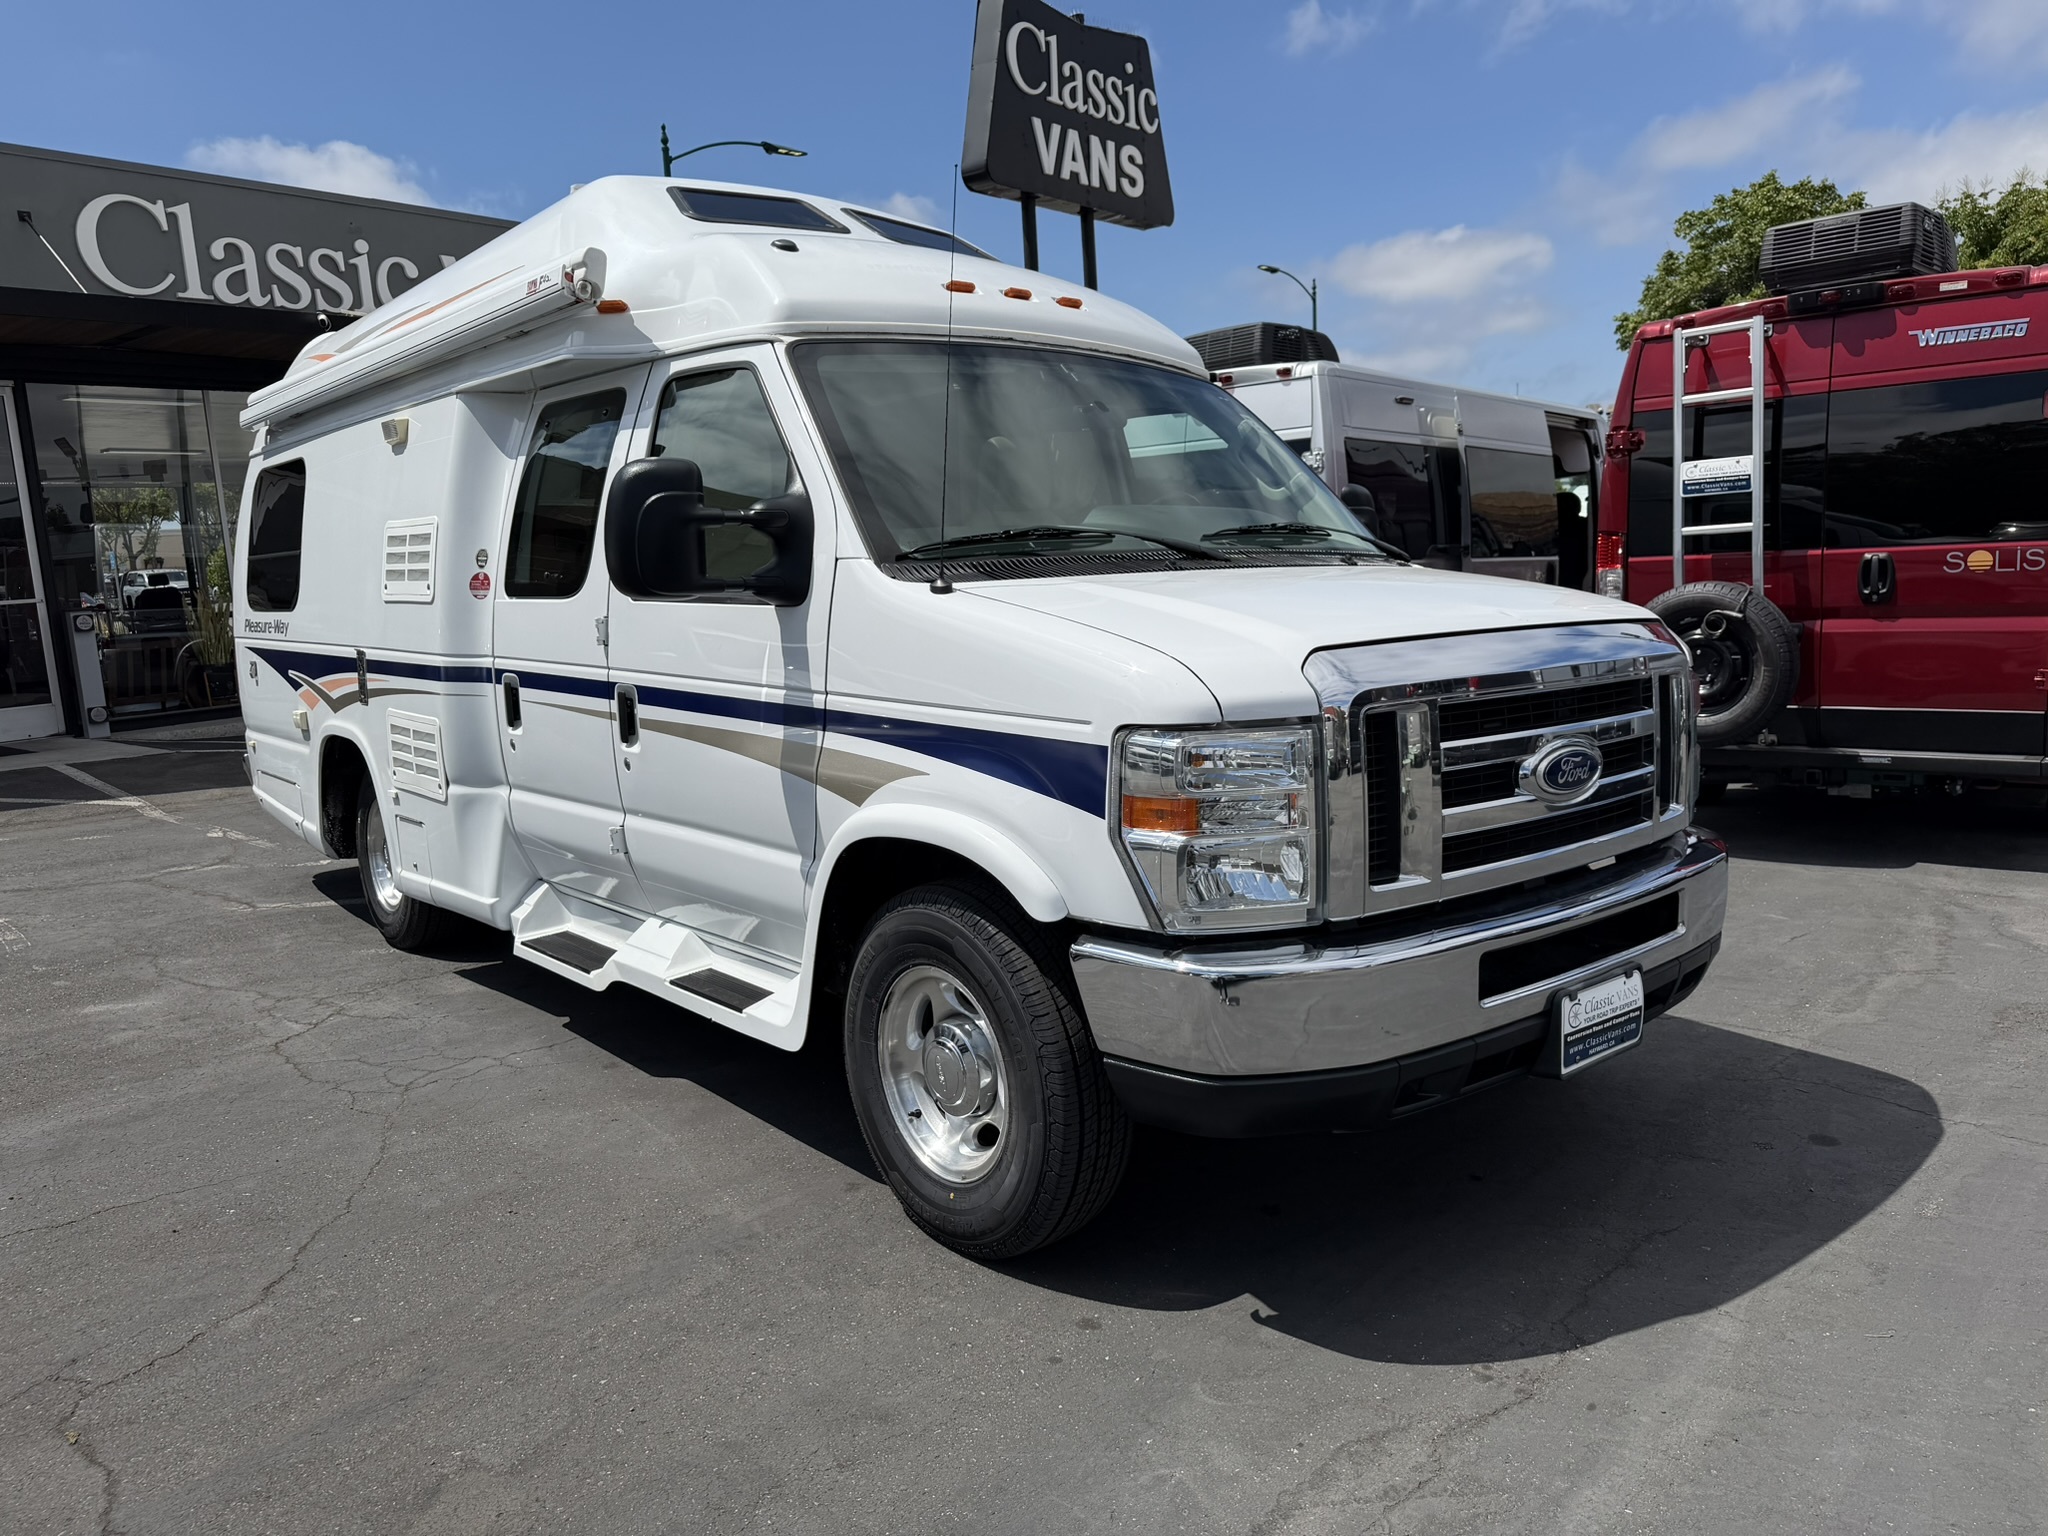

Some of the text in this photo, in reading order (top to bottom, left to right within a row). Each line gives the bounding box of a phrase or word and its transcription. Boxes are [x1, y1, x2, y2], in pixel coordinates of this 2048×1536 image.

[1006, 21, 1159, 134] Classic
[1031, 116, 1145, 198] VANS
[74, 193, 420, 316] Classic
[1908, 317, 2031, 348] WINNEBAGO
[244, 618, 290, 637] Pleasure-Way
[1557, 756, 1591, 784] Ford
[1583, 1014, 1596, 1024] YOUR
[1596, 1009, 1609, 1020] ROAD
[1609, 1005, 1619, 1015] TRIP
[1584, 984, 1639, 1015] Classic VANS
[1569, 1022, 1637, 1054] www.ClassicVans.com
